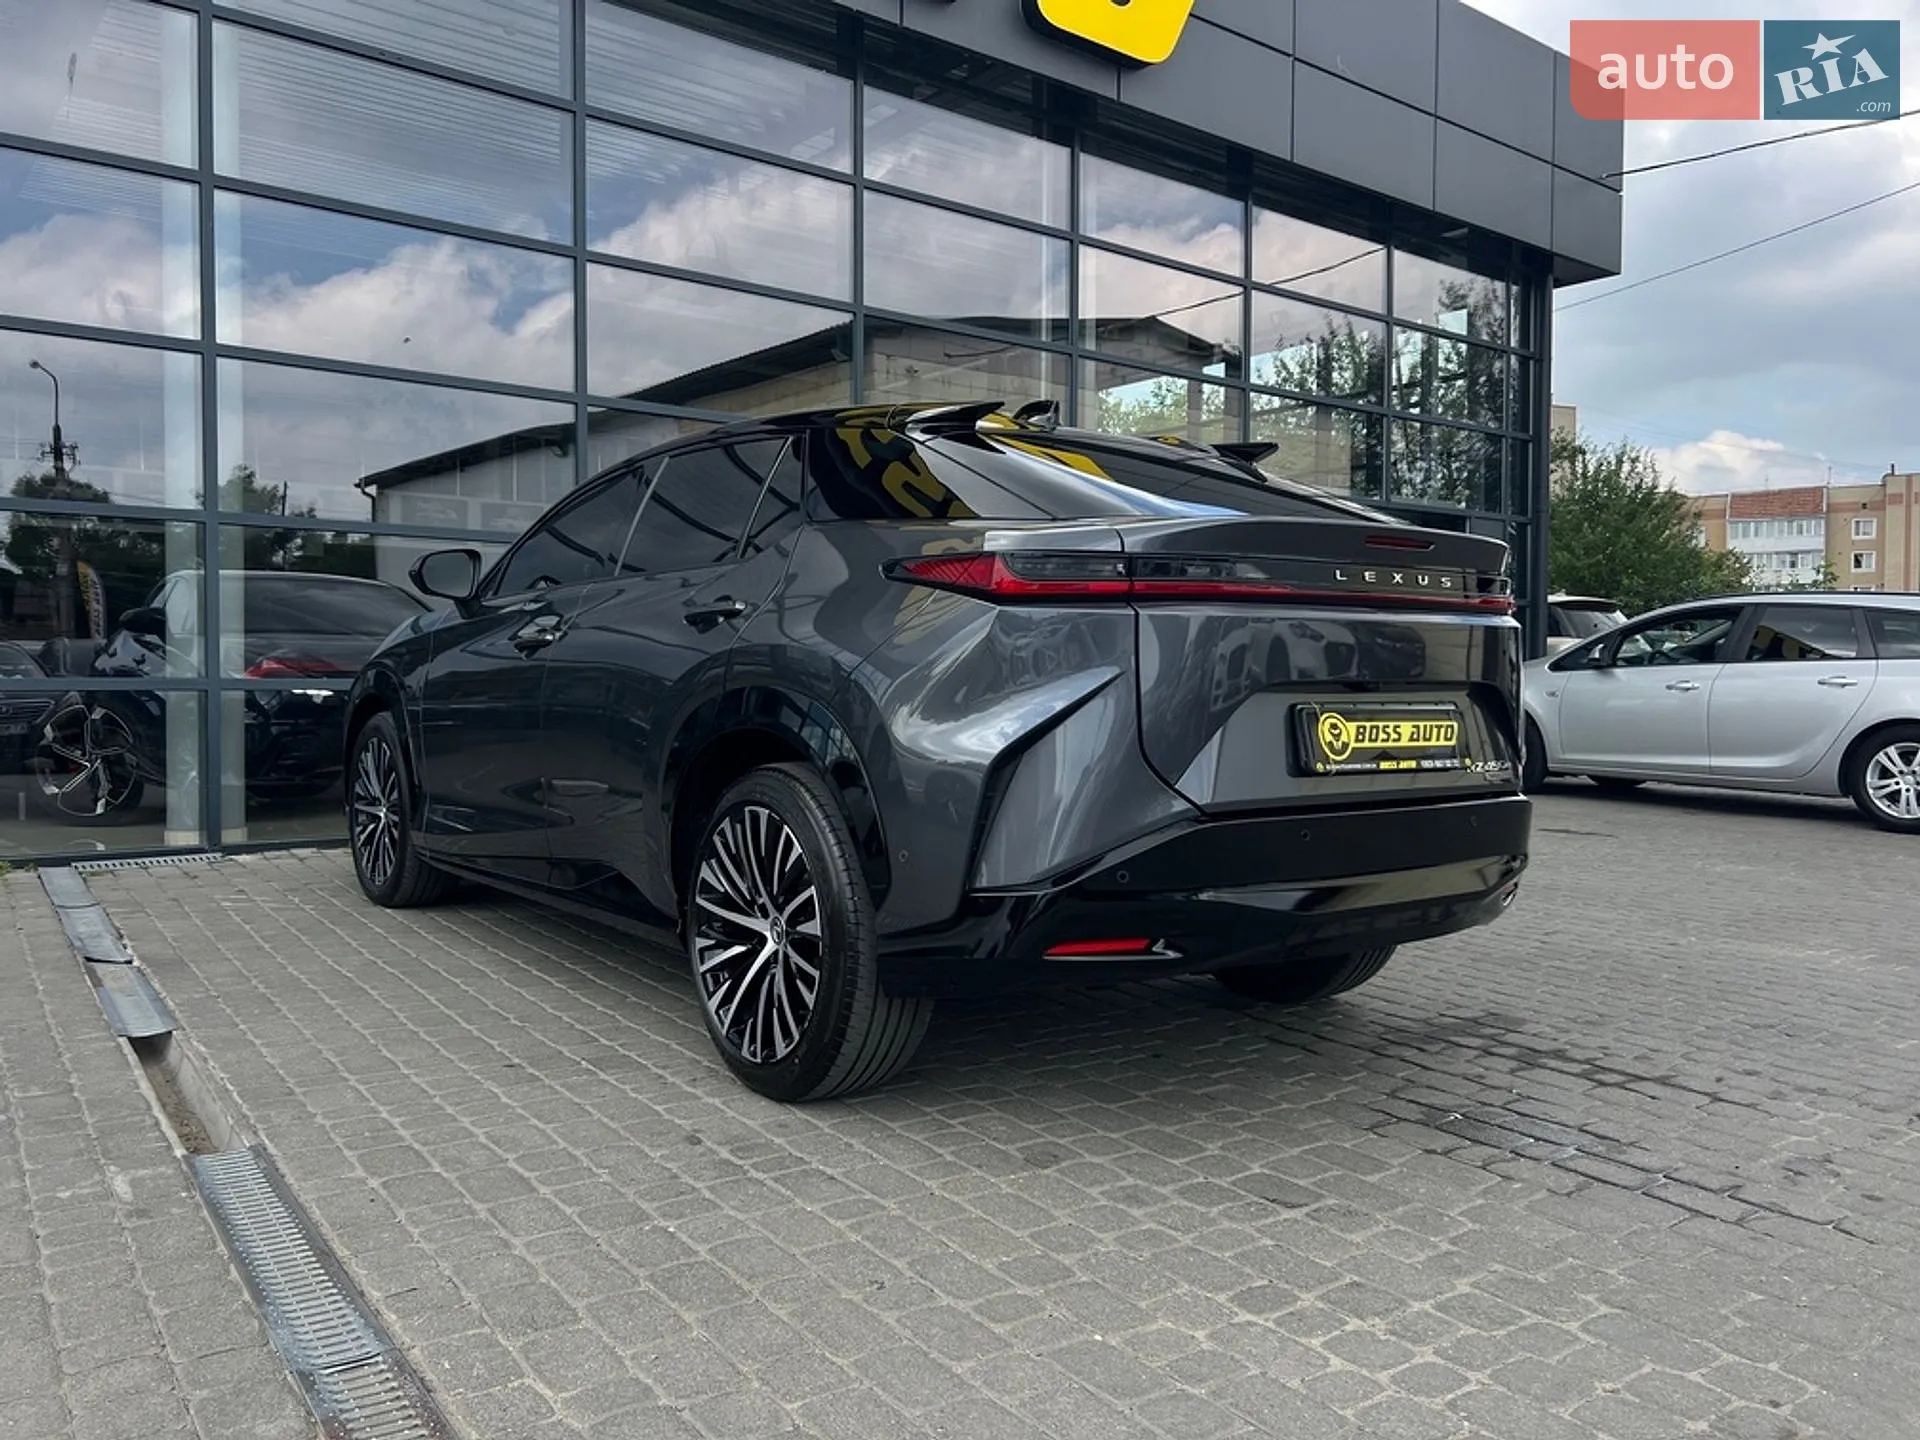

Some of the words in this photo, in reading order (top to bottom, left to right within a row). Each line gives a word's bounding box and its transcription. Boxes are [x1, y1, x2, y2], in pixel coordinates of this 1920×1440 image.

[1336, 569, 1452, 588] LEXUS
[1355, 724, 1401, 743] BOSS
[1409, 724, 1455, 742] AUTO
